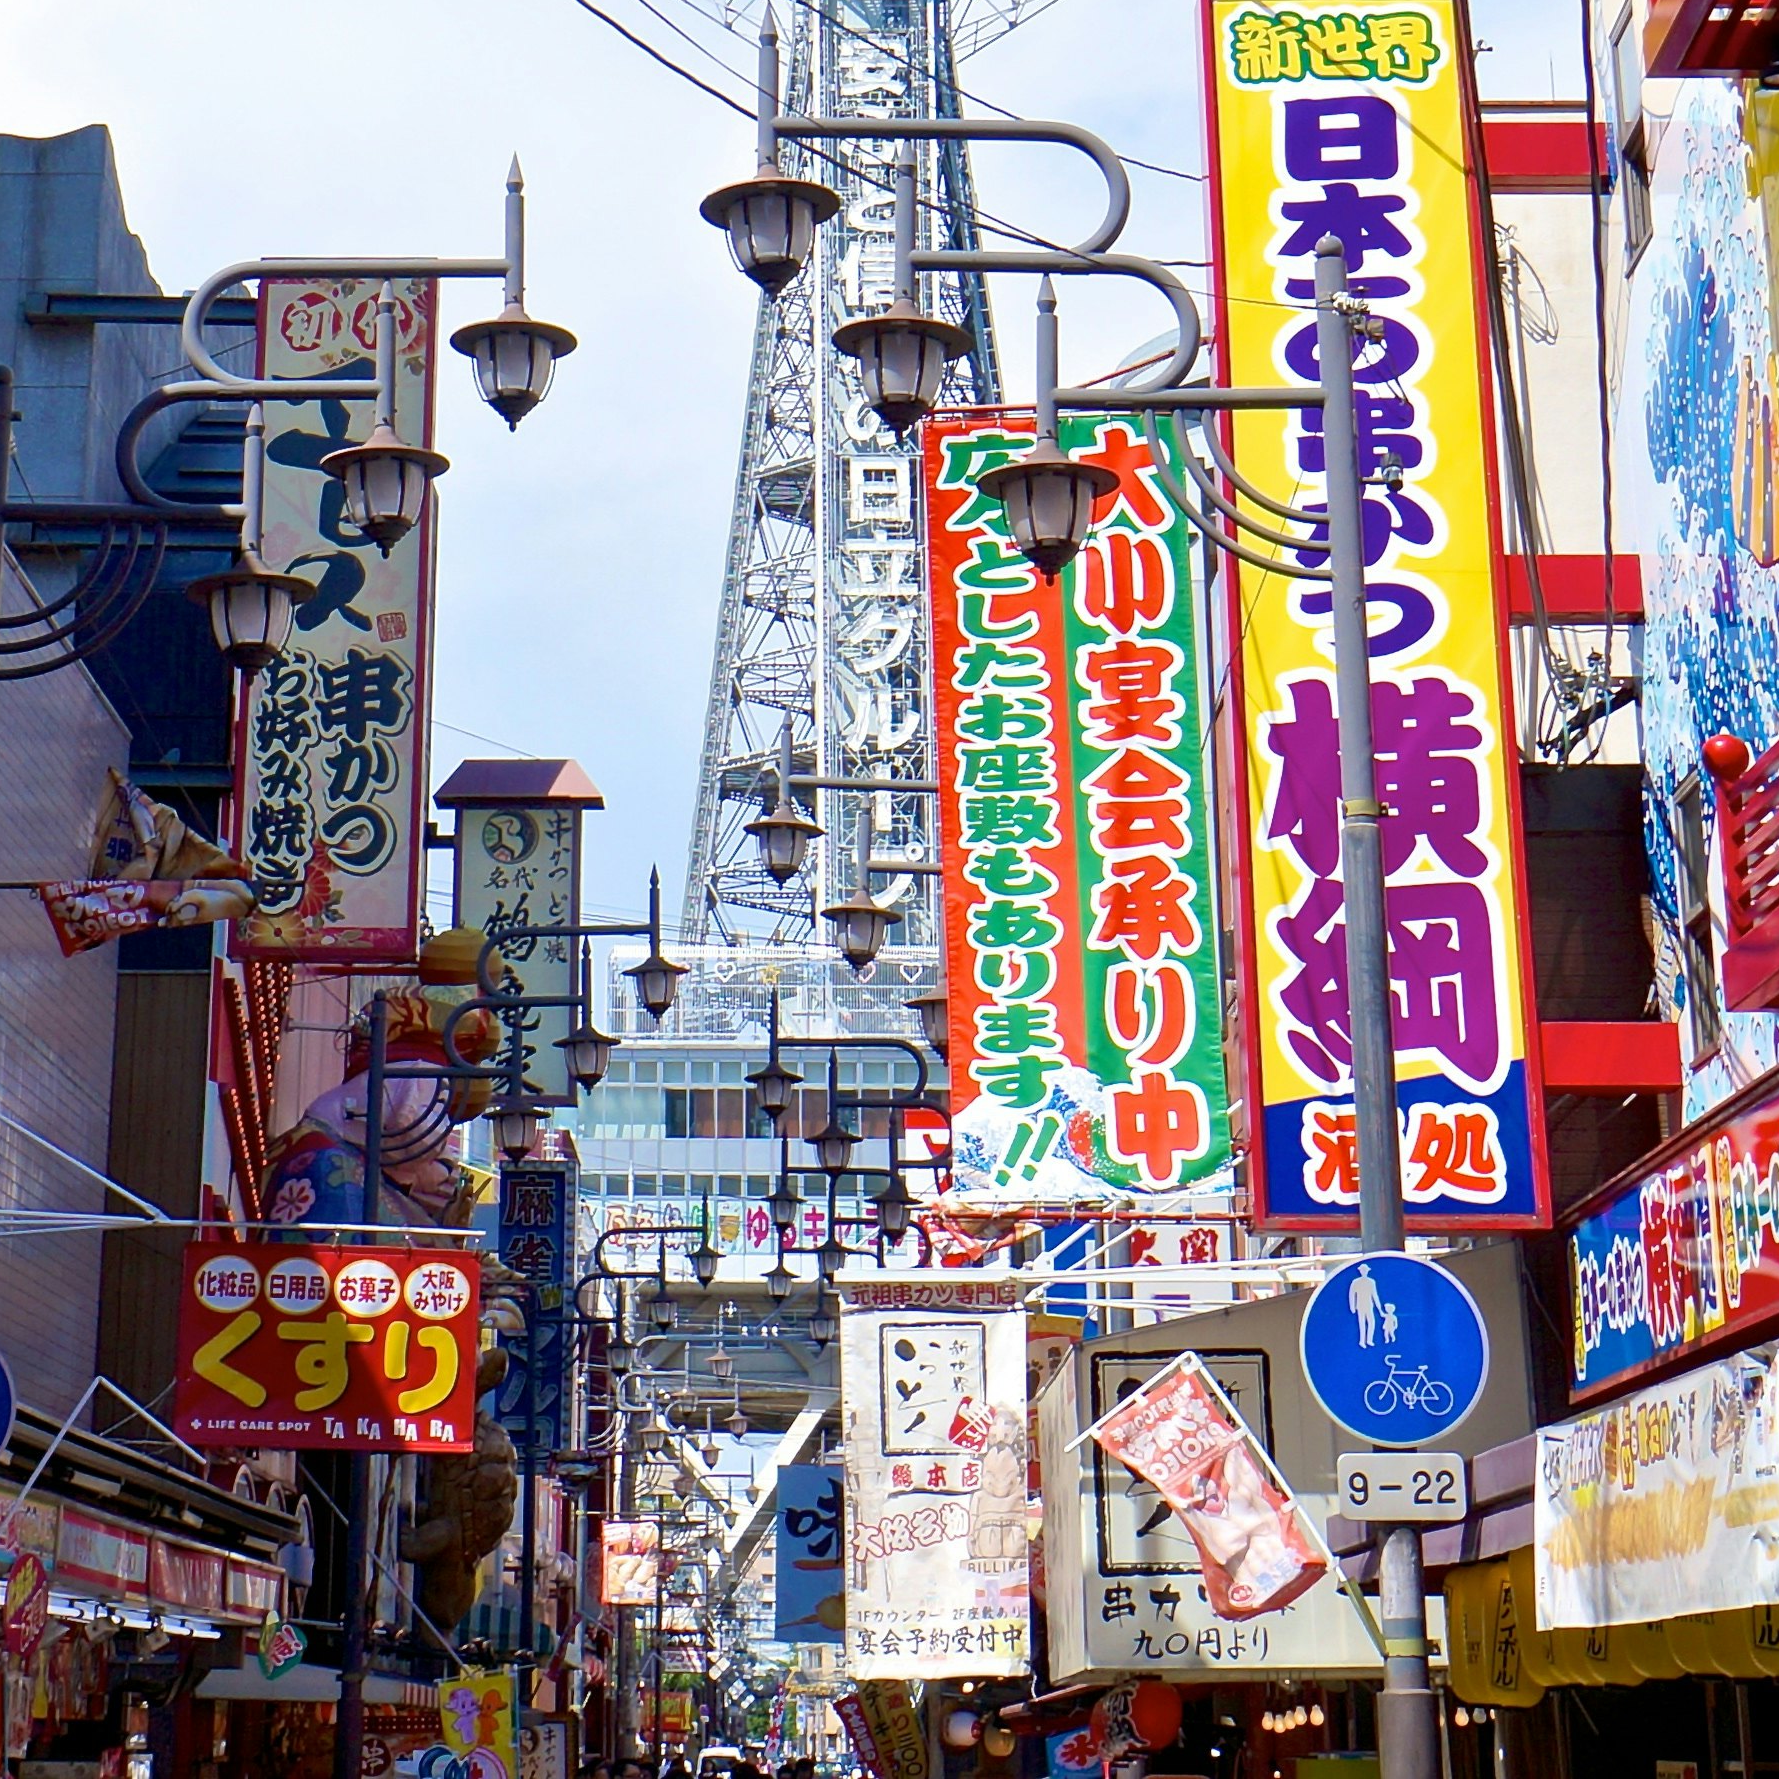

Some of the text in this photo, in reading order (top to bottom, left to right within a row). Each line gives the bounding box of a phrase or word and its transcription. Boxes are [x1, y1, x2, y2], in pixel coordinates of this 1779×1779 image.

[1232, 12, 1439, 84] 新世界
[1277, 95, 1436, 658] 日本一の串かつ
[315, 648, 405, 868] 串かつ
[249, 649, 312, 908] お好み焼き
[1267, 677, 1499, 1085] 横綱
[543, 890, 568, 964] ど焼
[197, 1270, 257, 1298] 化粧品
[269, 1274, 326, 1301] 日用品
[339, 1275, 397, 1304] お菓子
[421, 1270, 456, 1290] 大阪
[412, 1291, 464, 1312] みやげ
[192, 1310, 460, 1415] くすり
[207, 1419, 235, 1430] LIFE
[239, 1420, 274, 1431] CARE
[277, 1421, 312, 1432] SPOT
[1348, 1469, 1457, 1508] 9-22
[854, 1626, 1022, 1657] 宴会予約受付中
